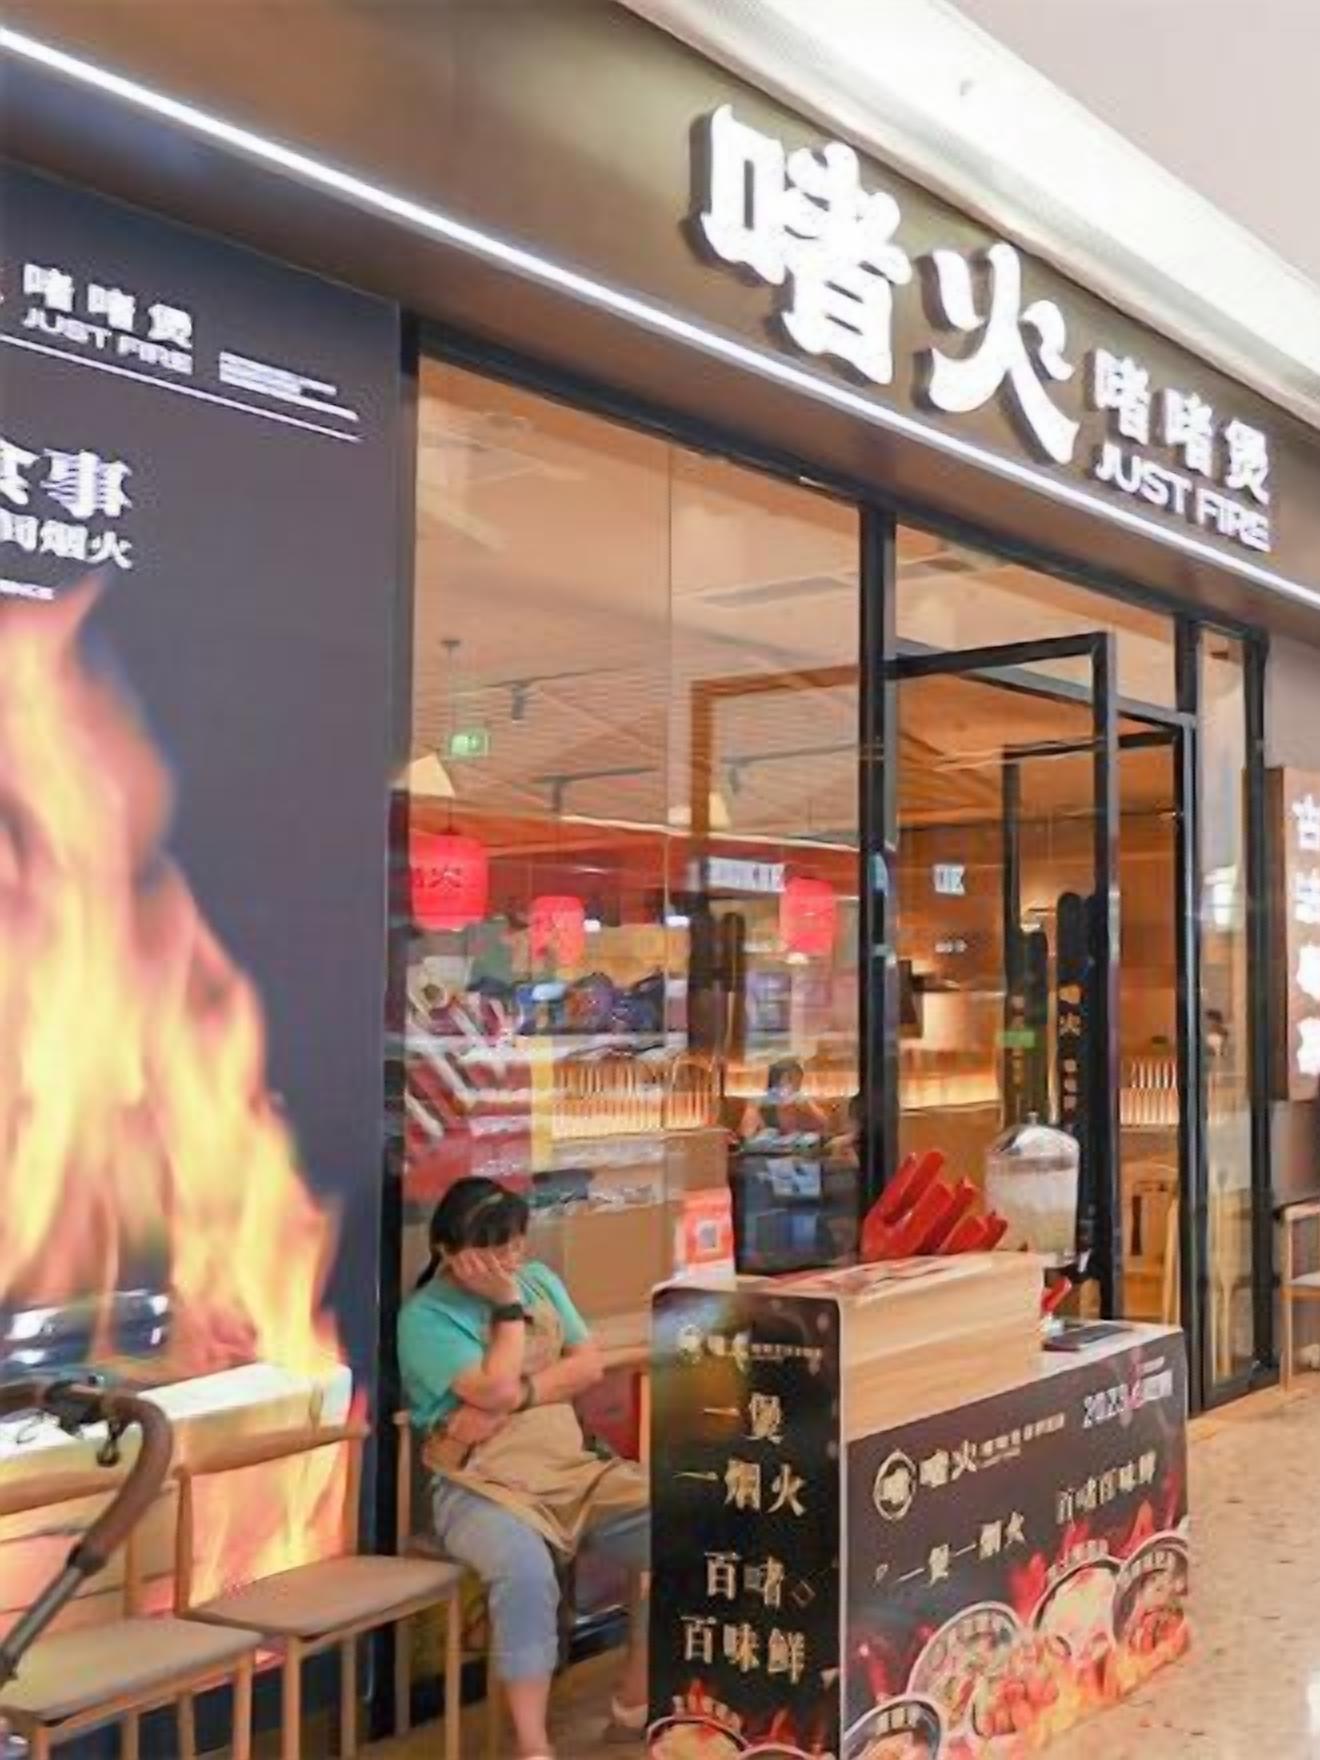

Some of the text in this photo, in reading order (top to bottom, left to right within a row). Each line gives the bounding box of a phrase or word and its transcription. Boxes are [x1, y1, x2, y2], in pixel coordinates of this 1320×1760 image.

[23, 308, 112, 349] JUST
[700, 103, 1081, 466] 啫火
[1096, 441, 1271, 553] JUST FIRE
